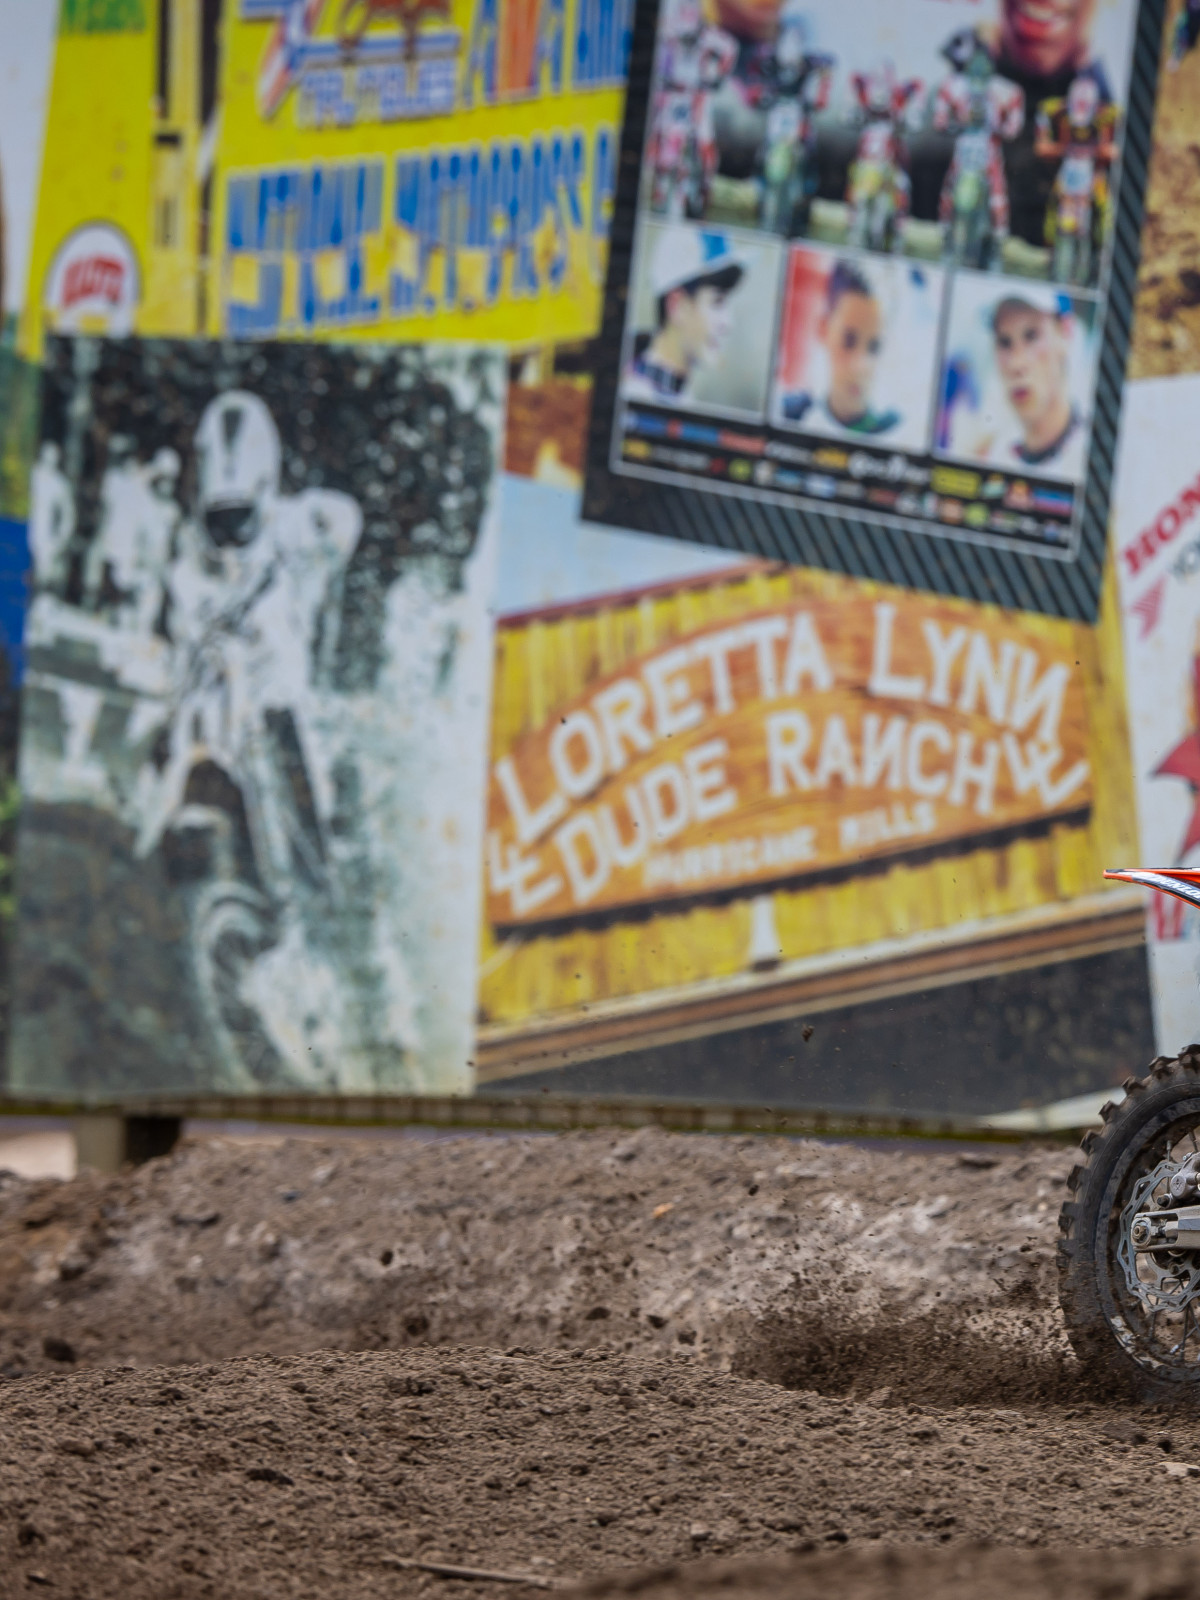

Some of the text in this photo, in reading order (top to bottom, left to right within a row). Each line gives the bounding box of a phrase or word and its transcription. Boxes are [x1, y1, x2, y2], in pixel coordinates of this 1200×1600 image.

[494, 602, 1072, 846] LORETTA LYNN
[556, 709, 1000, 903] DUDE RANCH
